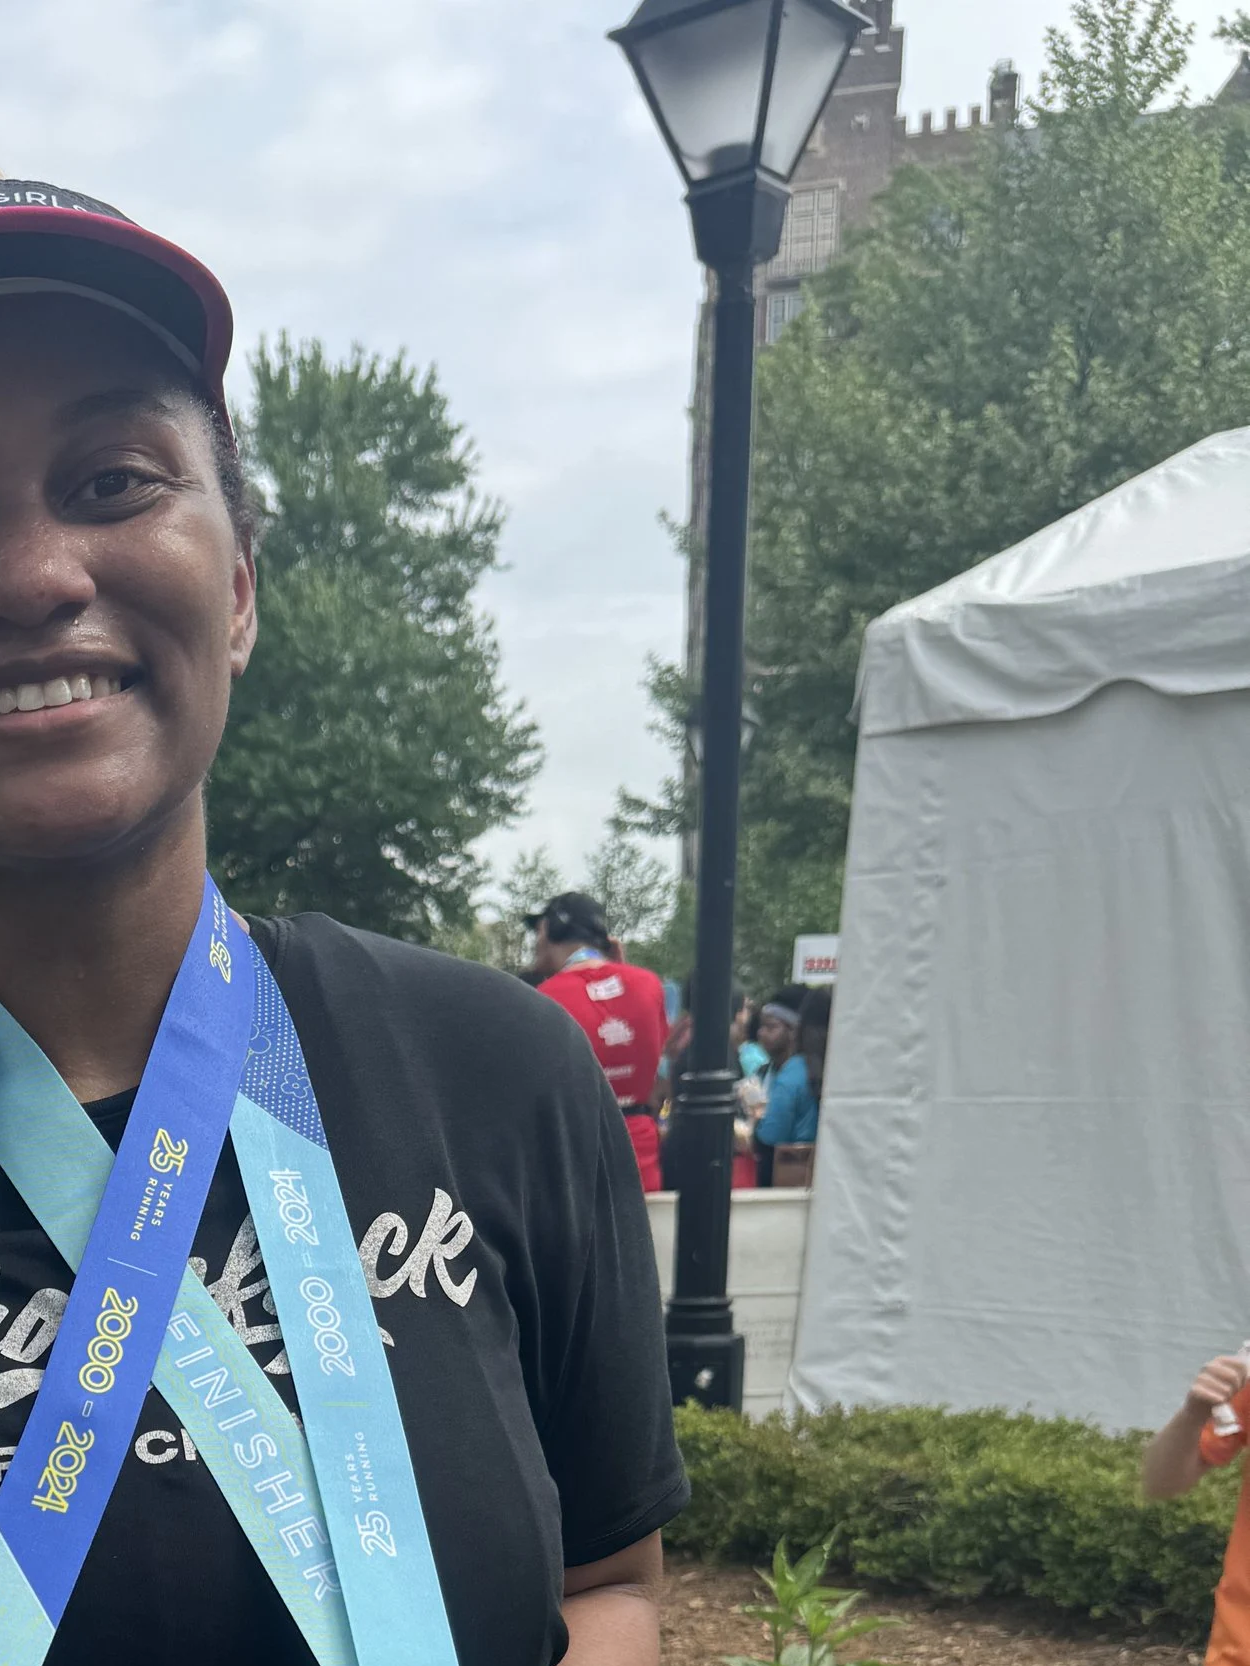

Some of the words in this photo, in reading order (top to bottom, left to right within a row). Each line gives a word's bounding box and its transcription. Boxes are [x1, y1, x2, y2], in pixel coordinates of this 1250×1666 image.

[210, 933, 231, 984] 25
[149, 1128, 189, 1177] 25
[130, 1177, 159, 1241] RUNNING
[151, 1183, 173, 1226] YEARS
[269, 1167, 320, 1247] 2024
[79, 1287, 139, 1394] 2000
[299, 1276, 356, 1378] 2000
[31, 1421, 95, 1513] 2024
[344, 1452, 363, 1503] YEARS
[355, 1431, 380, 1502] RUNNING
[354, 1509, 398, 1558] 25
